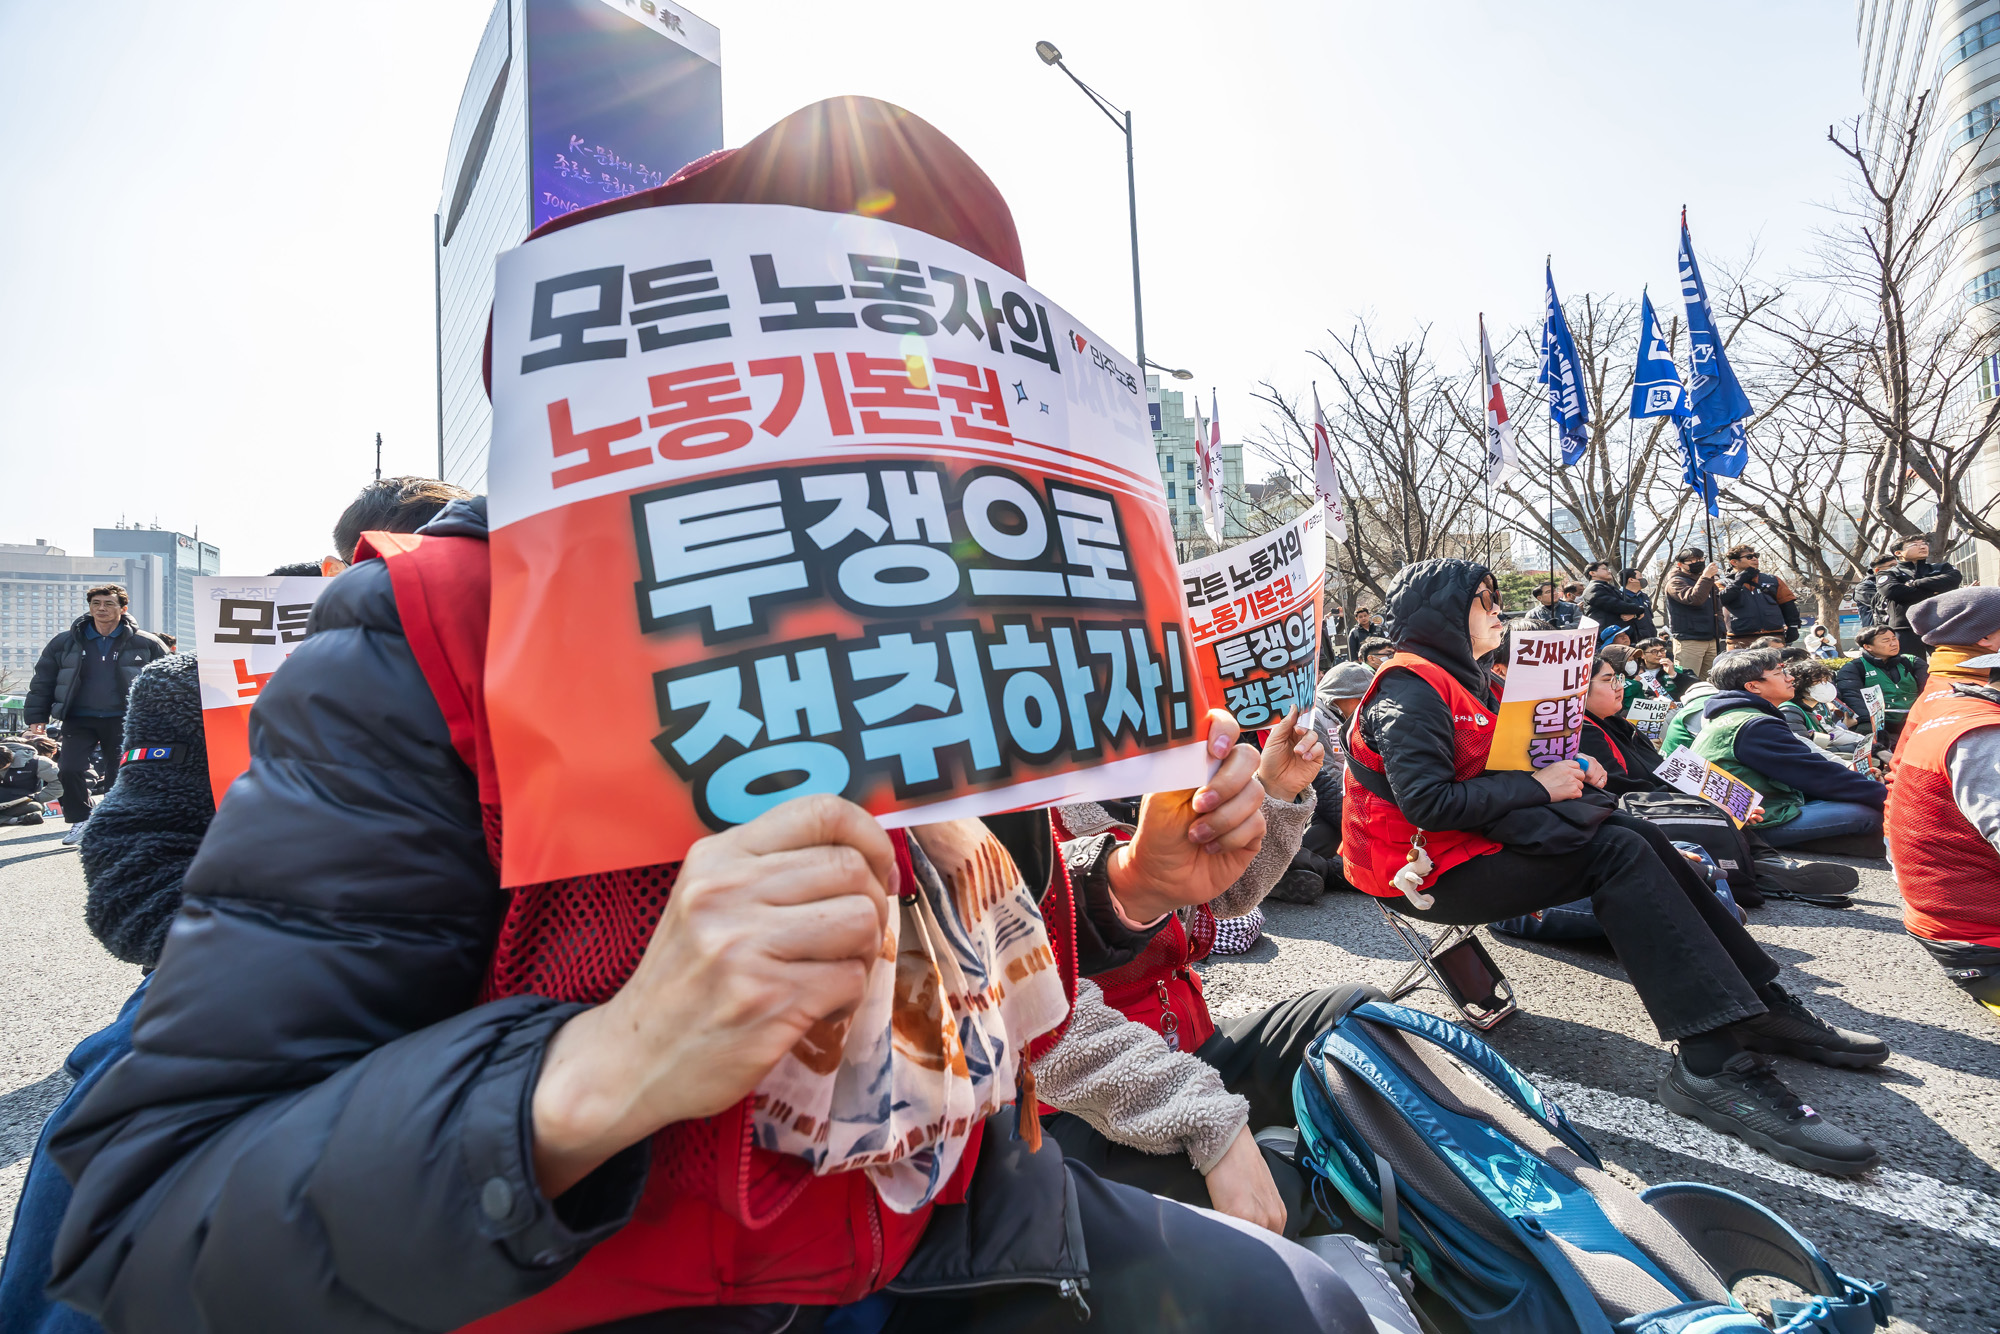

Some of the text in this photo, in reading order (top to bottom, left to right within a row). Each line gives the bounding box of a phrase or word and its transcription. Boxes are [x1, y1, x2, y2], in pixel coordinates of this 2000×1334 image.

[553, 153, 594, 184] 종로는
[520, 253, 1060, 375] 모든 노동자의
[1090, 344, 1138, 395] 민주노총
[546, 351, 1013, 490] 노동기본권
[640, 467, 1140, 634] 투쟁으로
[1228, 525, 1303, 593] 노동자의
[1189, 574, 1295, 643] 노동기본권
[1215, 602, 1316, 679] 투쟁으로
[1516, 633, 1596, 667] 진짜사장
[664, 618, 1190, 826] 쟁취하자!
[1633, 700, 1669, 712] 진짜사장
